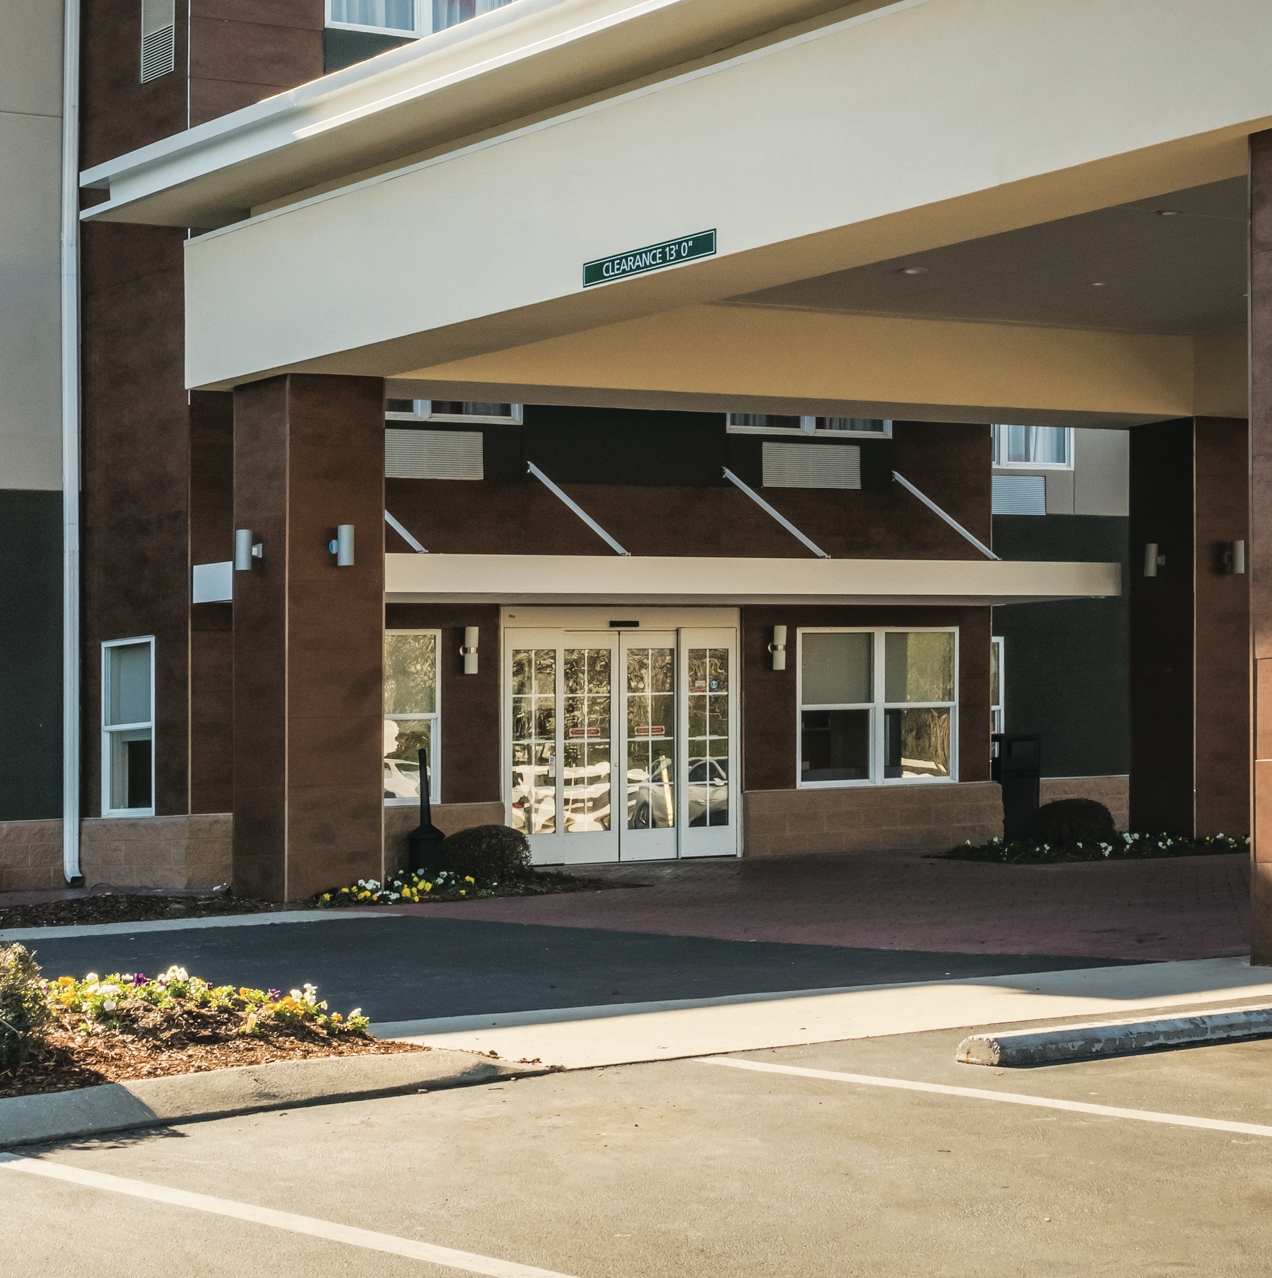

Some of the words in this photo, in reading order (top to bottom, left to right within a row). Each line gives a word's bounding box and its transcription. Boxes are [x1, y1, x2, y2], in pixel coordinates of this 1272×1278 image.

[602, 248, 663, 277] CLEARANCE
[665, 244, 679, 261] 13'
[681, 240, 693, 256] 0"
